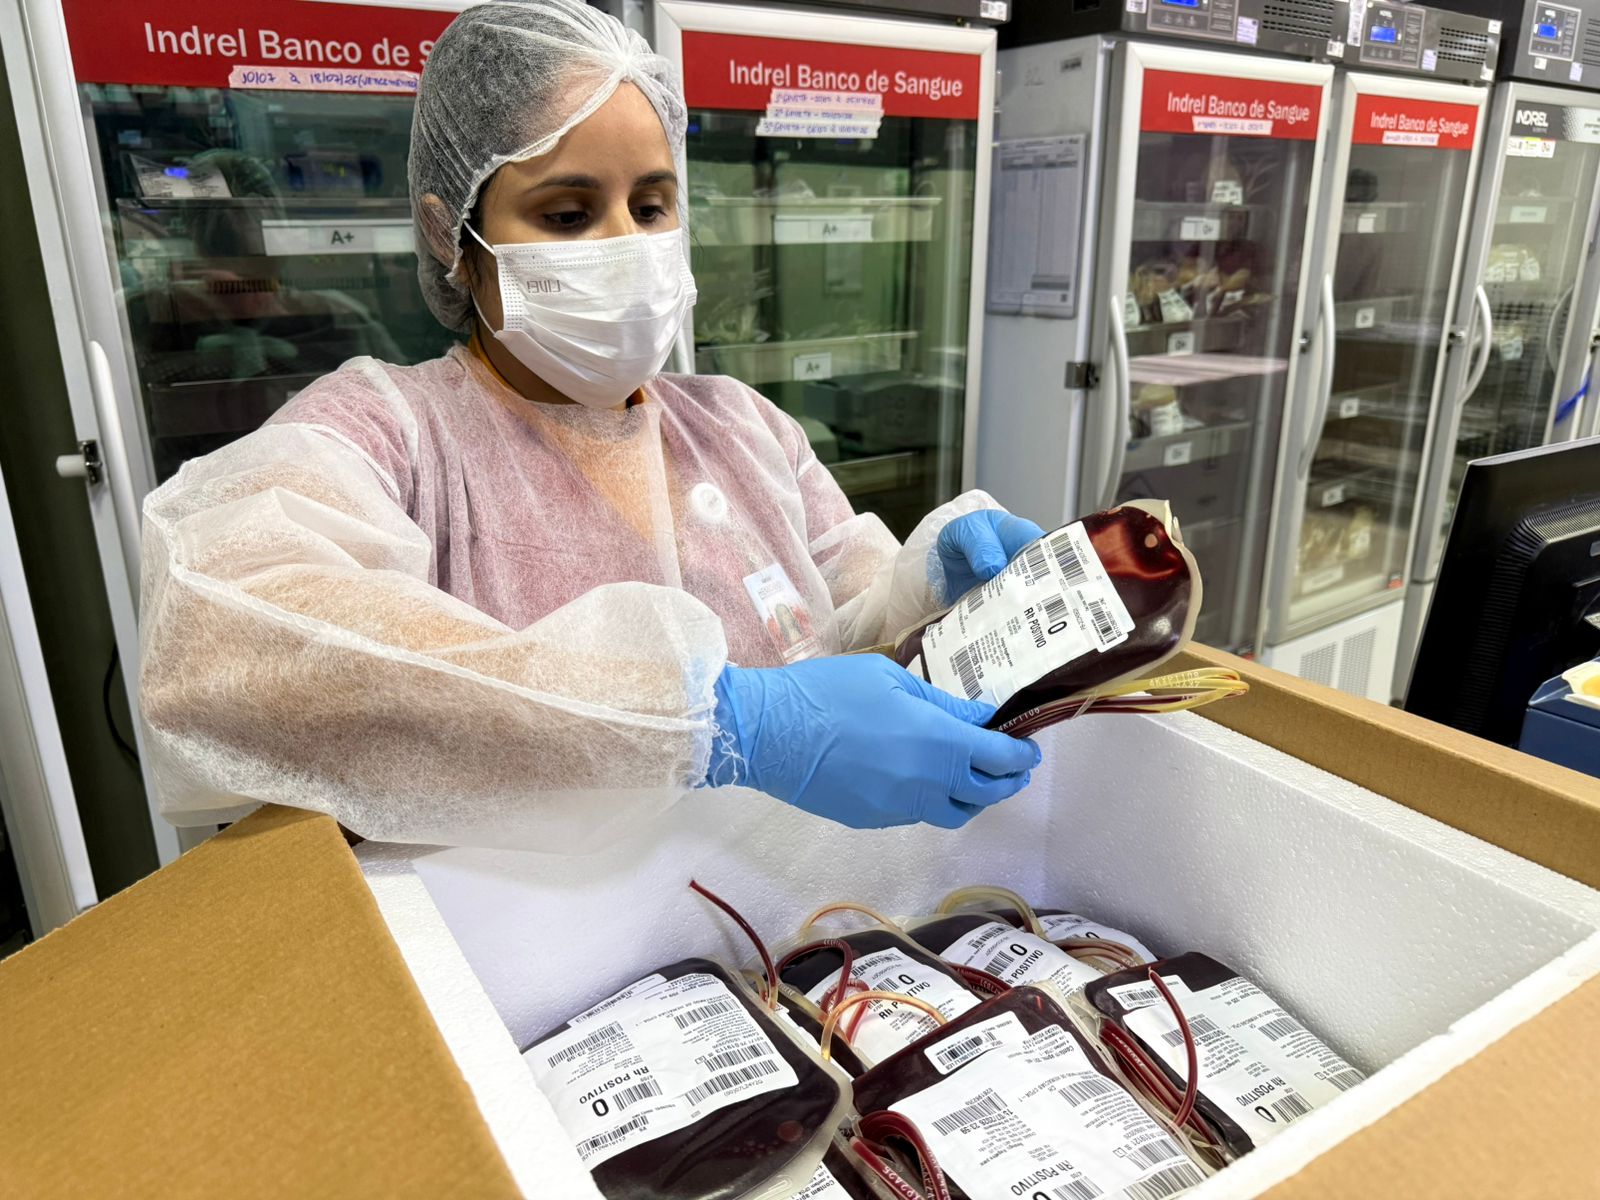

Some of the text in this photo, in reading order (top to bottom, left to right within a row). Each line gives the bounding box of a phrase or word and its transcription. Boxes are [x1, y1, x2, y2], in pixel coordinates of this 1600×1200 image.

[144, 22, 247, 58] Indrel
[259, 30, 361, 65] Banco
[372, 38, 409, 67] de
[730, 60, 962, 100] Indrel Banco de Sangue
[1167, 92, 1205, 114] Indrel
[1208, 98, 1246, 117] Banco
[1250, 103, 1264, 118] de
[1267, 101, 1309, 125] Sangue
[1371, 112, 1469, 137] Indrel Banco de Sangue
[331, 230, 355, 246] A+
[823, 223, 838, 235] A+
[806, 362, 820, 374] A+
[1022, 606, 1046, 648] Rh POSITIVO
[1011, 948, 1043, 979] POSITIVO
[877, 980, 931, 1020] Rh PITIVO
[578, 1064, 649, 1104] Rh POSITIVO
[1235, 1075, 1285, 1106] Rh POSITIVO
[810, 1179, 835, 1195] Contem
[1010, 1159, 1074, 1196] Rh POSITIVO
